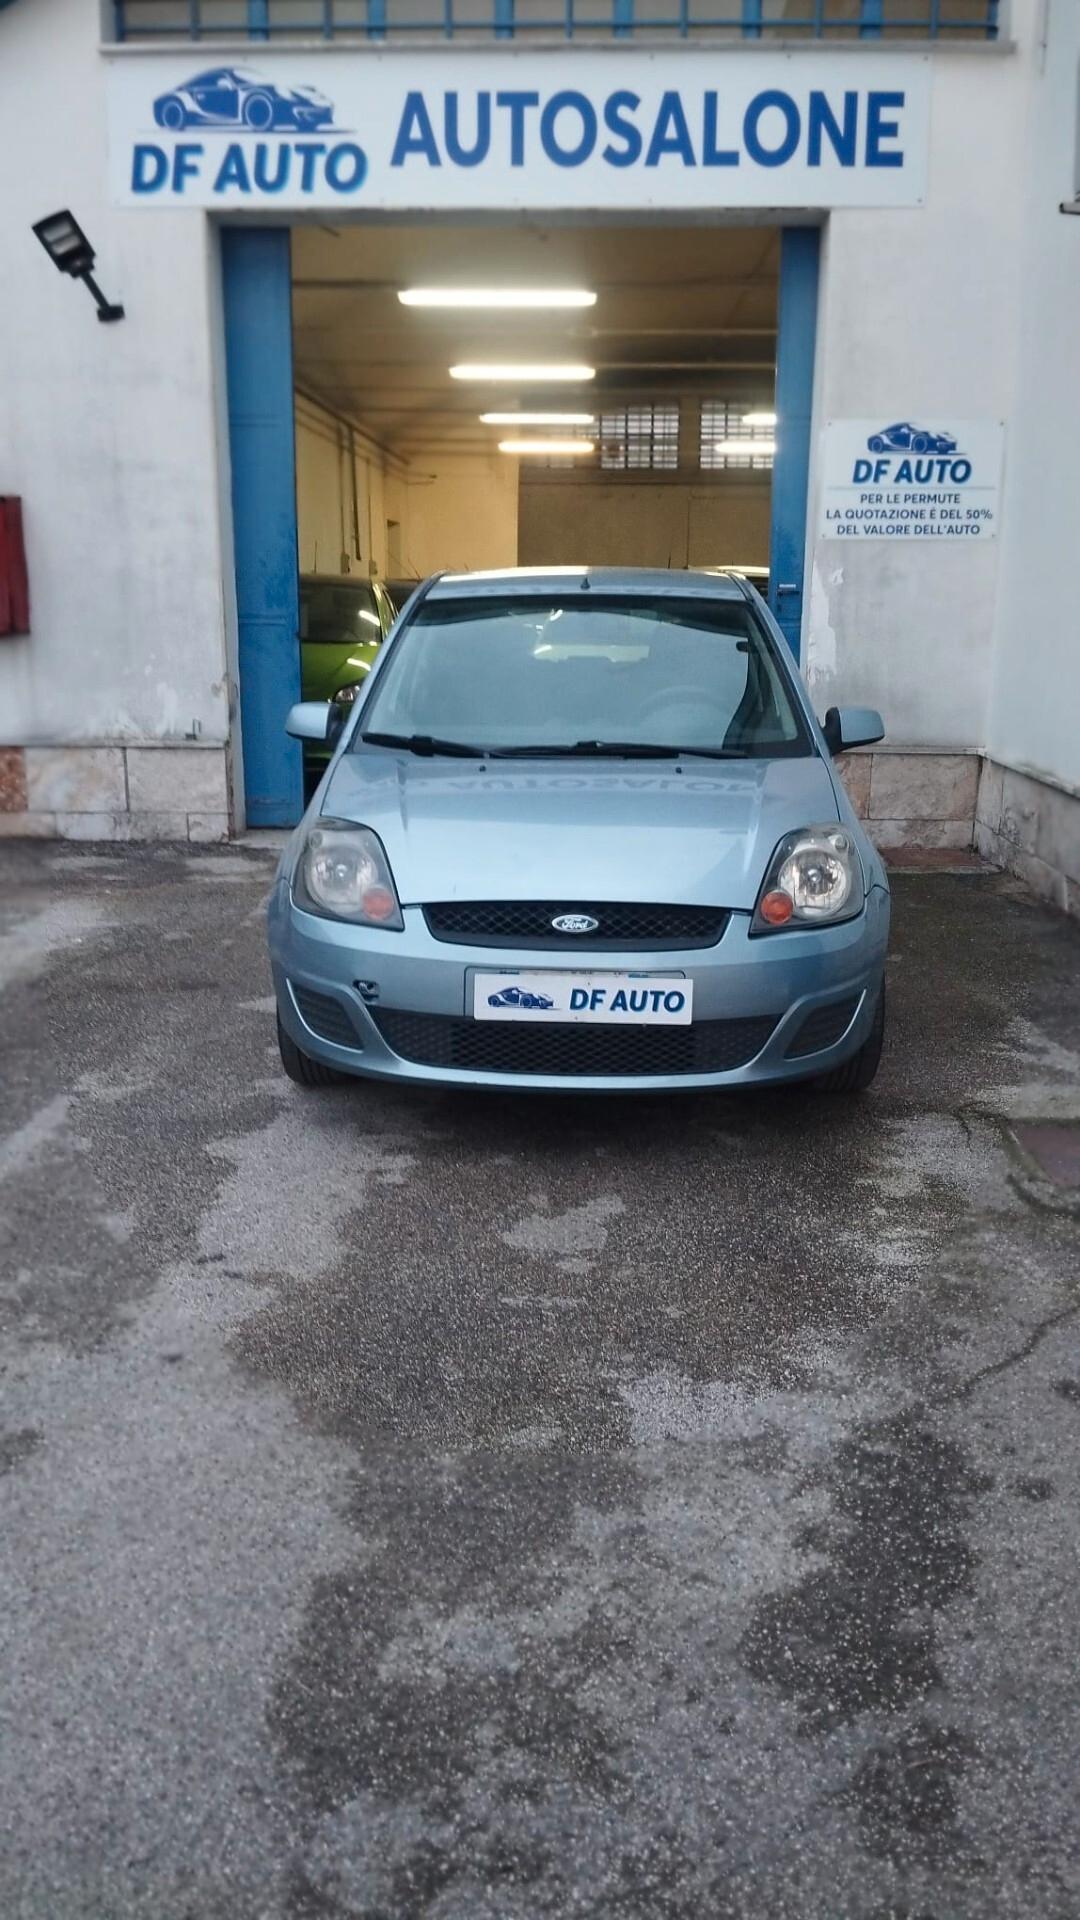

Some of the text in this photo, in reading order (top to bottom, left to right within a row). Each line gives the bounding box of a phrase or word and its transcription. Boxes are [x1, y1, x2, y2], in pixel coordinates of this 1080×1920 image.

[390, 89, 905, 168] AUTOSALONE
[131, 142, 368, 194] DF AUTO
[852, 459, 972, 484] DF AUTO
[860, 493, 961, 504] PER LE PERMUTE
[826, 509, 842, 520] LA
[845, 509, 926, 520] QUOTAZIONE
[940, 509, 963, 520] DEL
[966, 509, 993, 520] 50%
[837, 524, 981, 535] DEL VALORE DELL'AUTO
[561, 917, 589, 930] Ford
[569, 988, 686, 1013] DF AUTO
